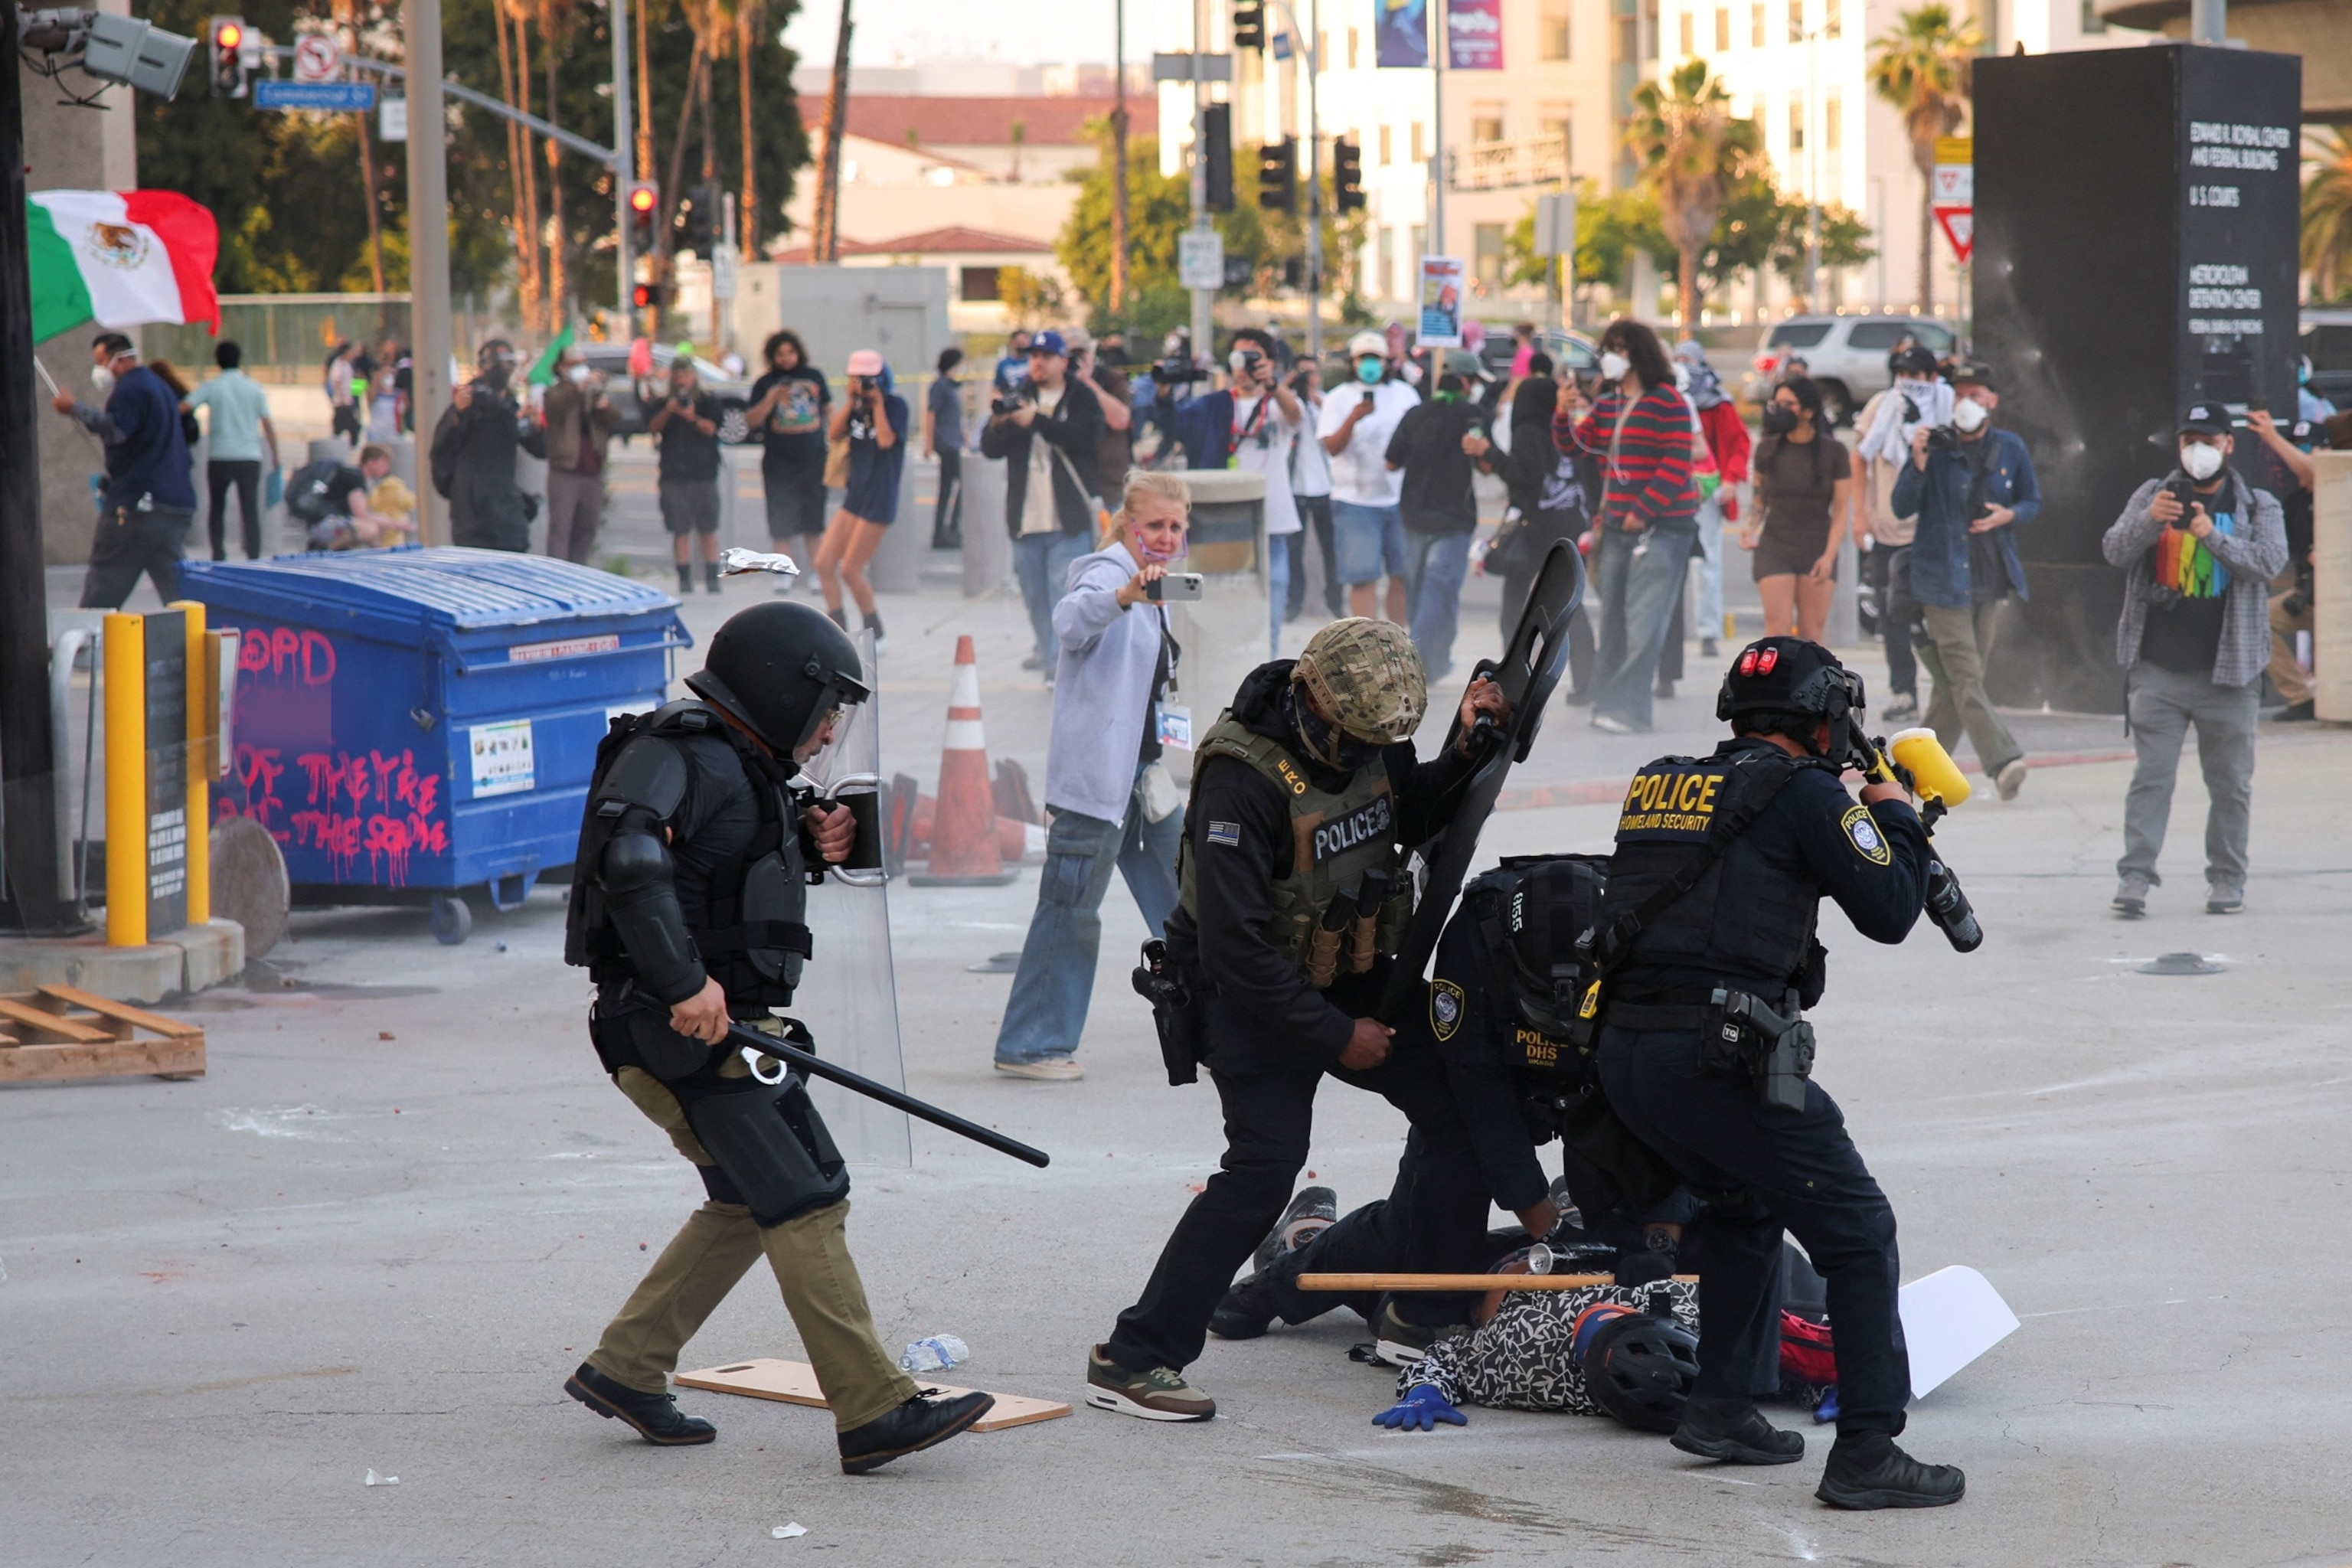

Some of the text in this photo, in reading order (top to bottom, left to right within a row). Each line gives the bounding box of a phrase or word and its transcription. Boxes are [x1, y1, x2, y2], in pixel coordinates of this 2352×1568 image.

[1278, 759, 1306, 794] ERO
[1624, 773, 1724, 813] POLICE
[1619, 813, 1710, 831] HOMELAND SECURITY
[1844, 809, 1868, 830] POLICE
[290, 808, 362, 856] THE
[1315, 806, 1378, 860] POLICE
[1511, 892, 1524, 932] 855
[1434, 982, 1461, 999] POLICE
[1516, 1029, 1569, 1048] POL
[1724, 1027, 1736, 1037] TQ
[1526, 1044, 1557, 1060] DHS
